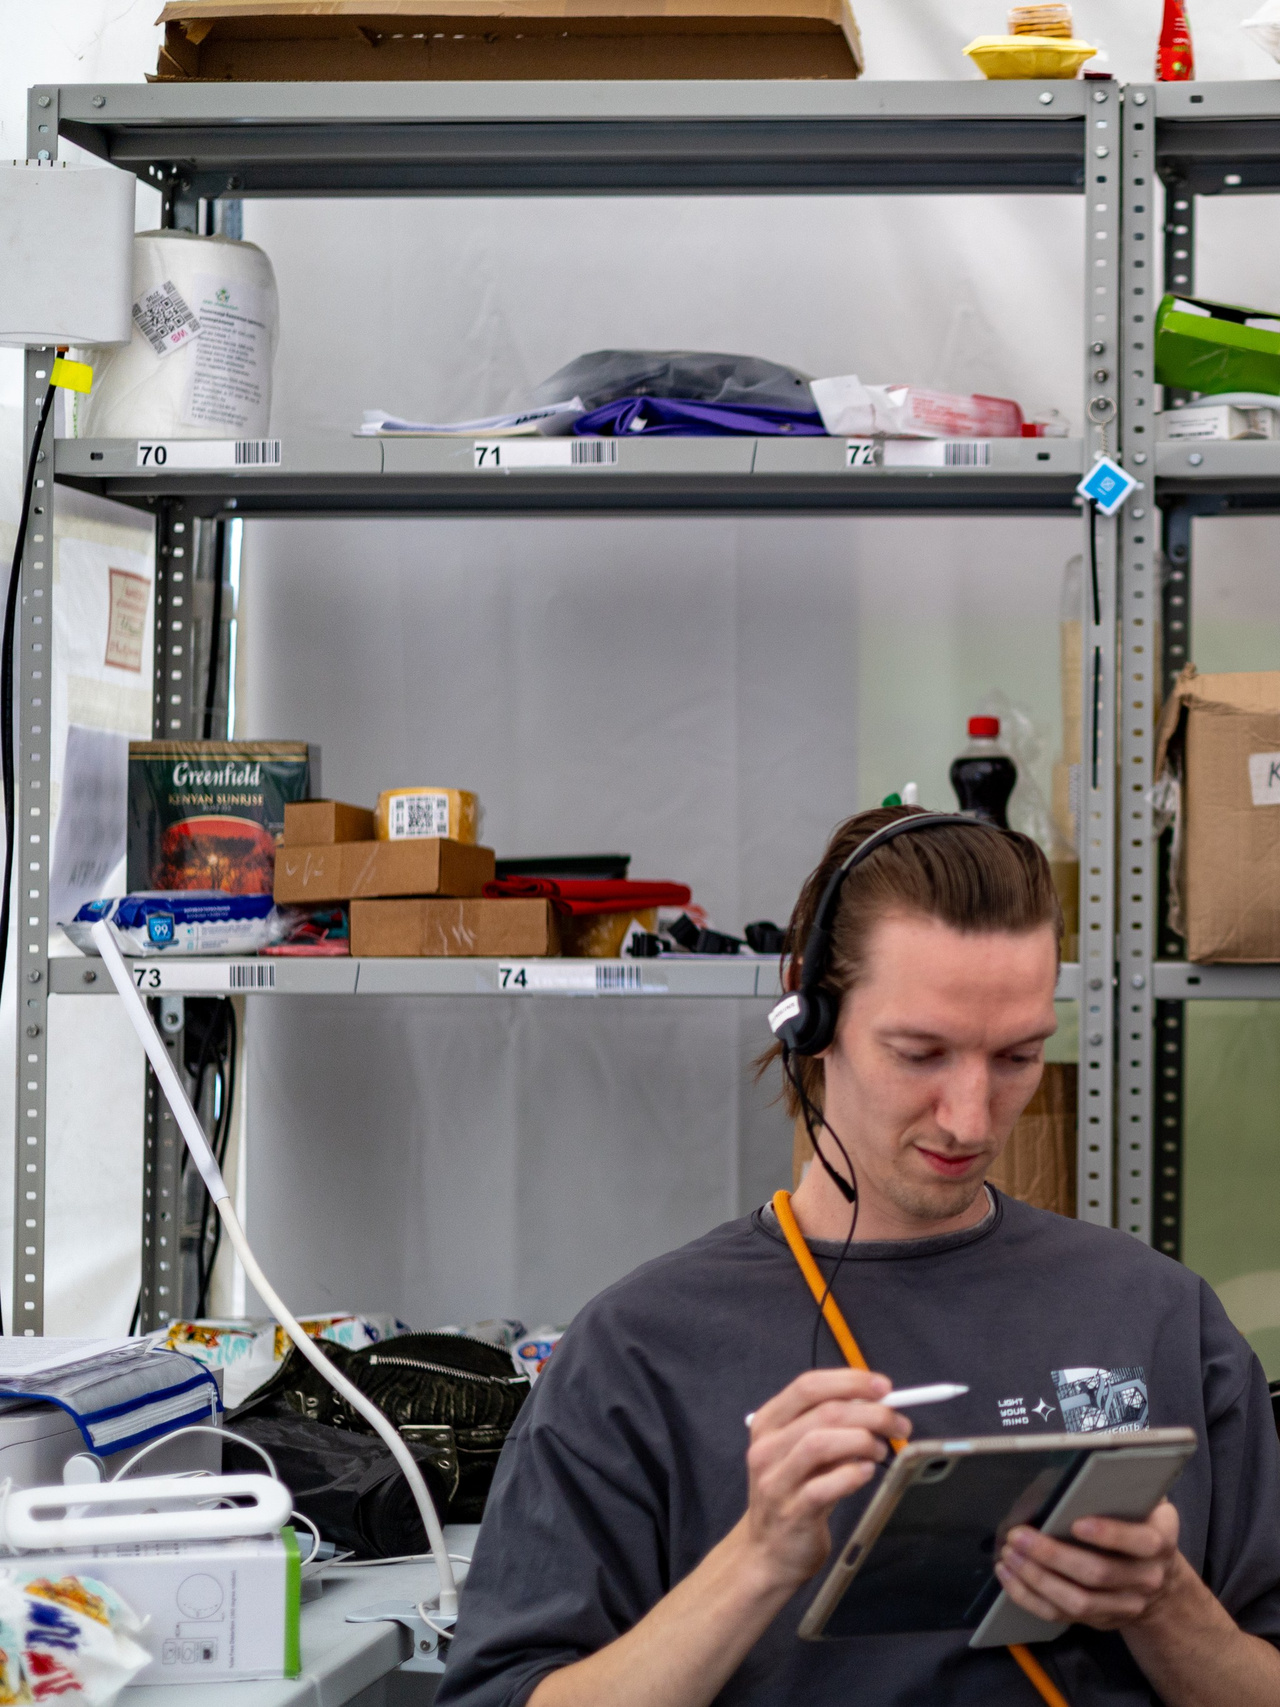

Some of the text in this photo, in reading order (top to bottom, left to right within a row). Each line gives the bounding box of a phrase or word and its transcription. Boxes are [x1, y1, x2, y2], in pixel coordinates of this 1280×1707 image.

[139, 445, 167, 466] 70
[475, 445, 502, 466] 71
[847, 445, 874, 465] 72
[172, 762, 261, 787] Greenfield
[168, 793, 264, 807] KENYAN SUNRISE
[134, 968, 162, 988] 73
[500, 967, 528, 988] 74
[998, 1397, 1024, 1408] LIGHT
[1000, 1407, 1027, 1417] YOUR
[1002, 1416, 1029, 1426] MIND
